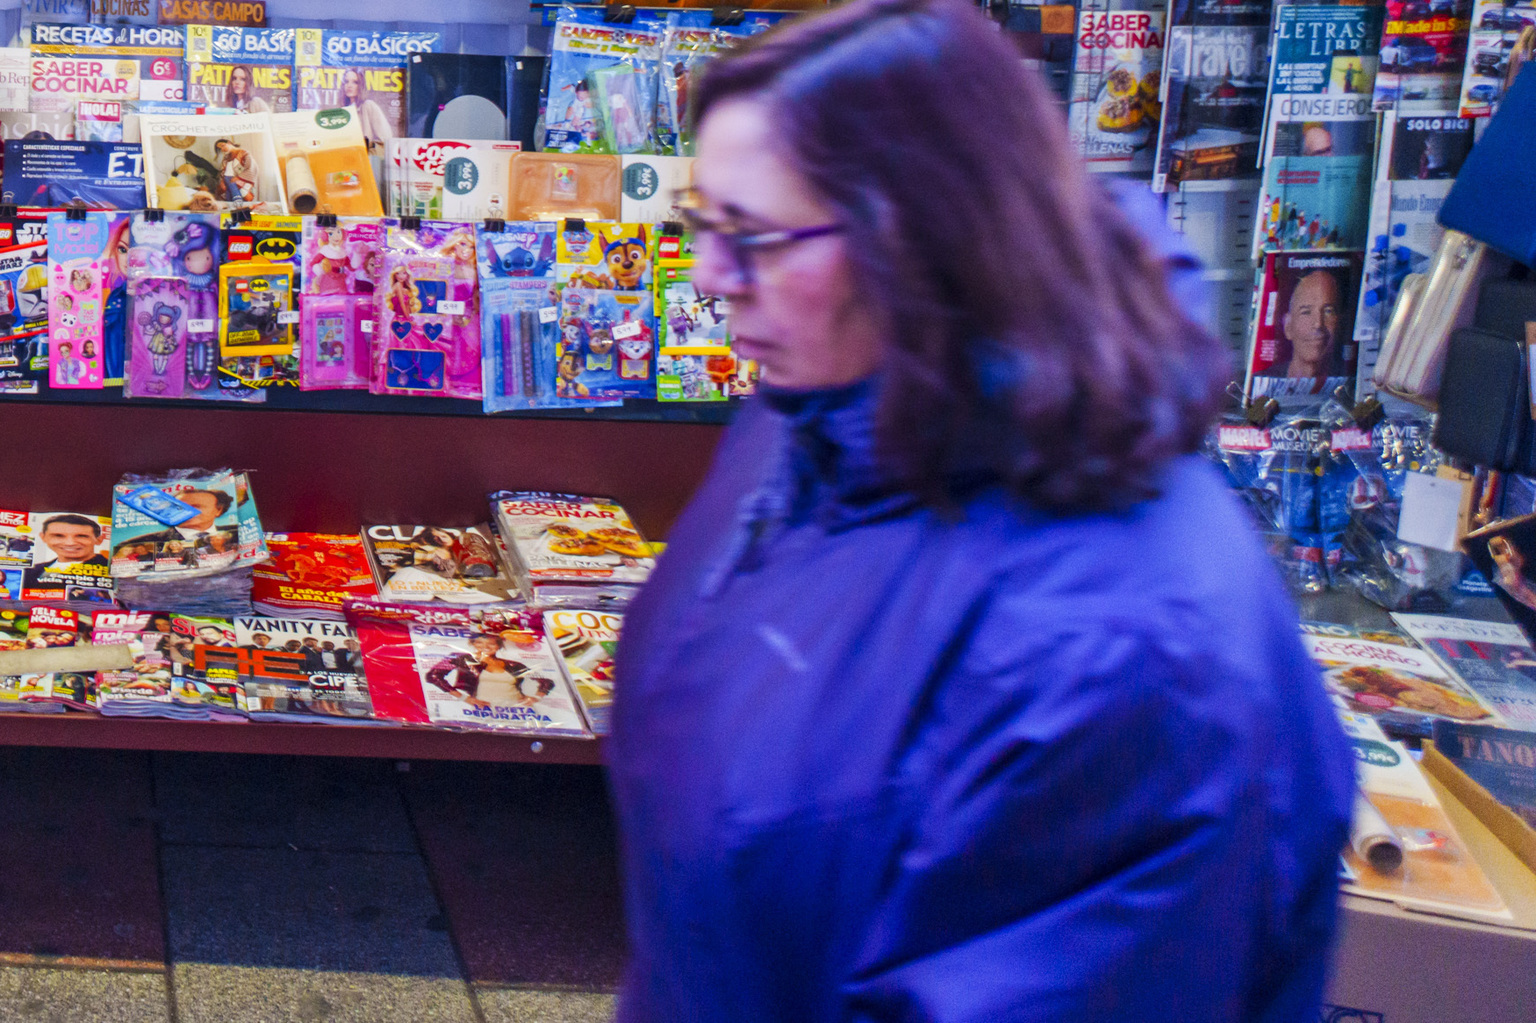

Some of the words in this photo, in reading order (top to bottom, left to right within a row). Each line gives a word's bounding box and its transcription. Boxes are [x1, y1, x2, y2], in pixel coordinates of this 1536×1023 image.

[162, 0, 210, 21] CASAS
[214, 0, 264, 24] CAMPO
[1081, 13, 1152, 32] SABER
[1278, 21, 1366, 39] LETRAS
[35, 26, 114, 45] RECETAS
[116, 27, 127, 44] al
[129, 28, 184, 46] HORN
[219, 34, 240, 51] 60
[245, 31, 293, 53] BÁSIC
[1078, 32, 1165, 50] COCINA
[327, 37, 352, 54] 60
[356, 33, 433, 56] BÁSICOS
[32, 60, 103, 77] SABER
[32, 77, 129, 94] COCINAR
[80, 102, 119, 118] ¡HOLA!
[152, 123, 208, 134] CROCHET
[1406, 119, 1440, 131] SOLO
[53, 222, 99, 242] TOP
[53, 242, 99, 254] Model
[229, 242, 251, 253] LEGO
[659, 242, 679, 253] LEGO
[1220, 428, 1271, 448] MARVEL
[1271, 428, 1320, 443] MOVIE
[503, 500, 582, 510] SABER
[505, 507, 615, 520] COCINAR
[96, 580, 112, 588] 60
[279, 586, 294, 594] El
[296, 588, 326, 597] año
[281, 592, 344, 604] CABALL
[31, 606, 57, 618] TELE
[95, 610, 152, 627] mia
[30, 614, 76, 627] NOVELA
[239, 618, 314, 637] VANITY
[415, 626, 474, 639] SABE
[1318, 640, 1401, 656] COCINA
[1346, 649, 1421, 667] HORNO
[463, 709, 552, 723] DEPURATIVA
[474, 704, 490, 713] LA
[494, 705, 537, 715] DIETA
